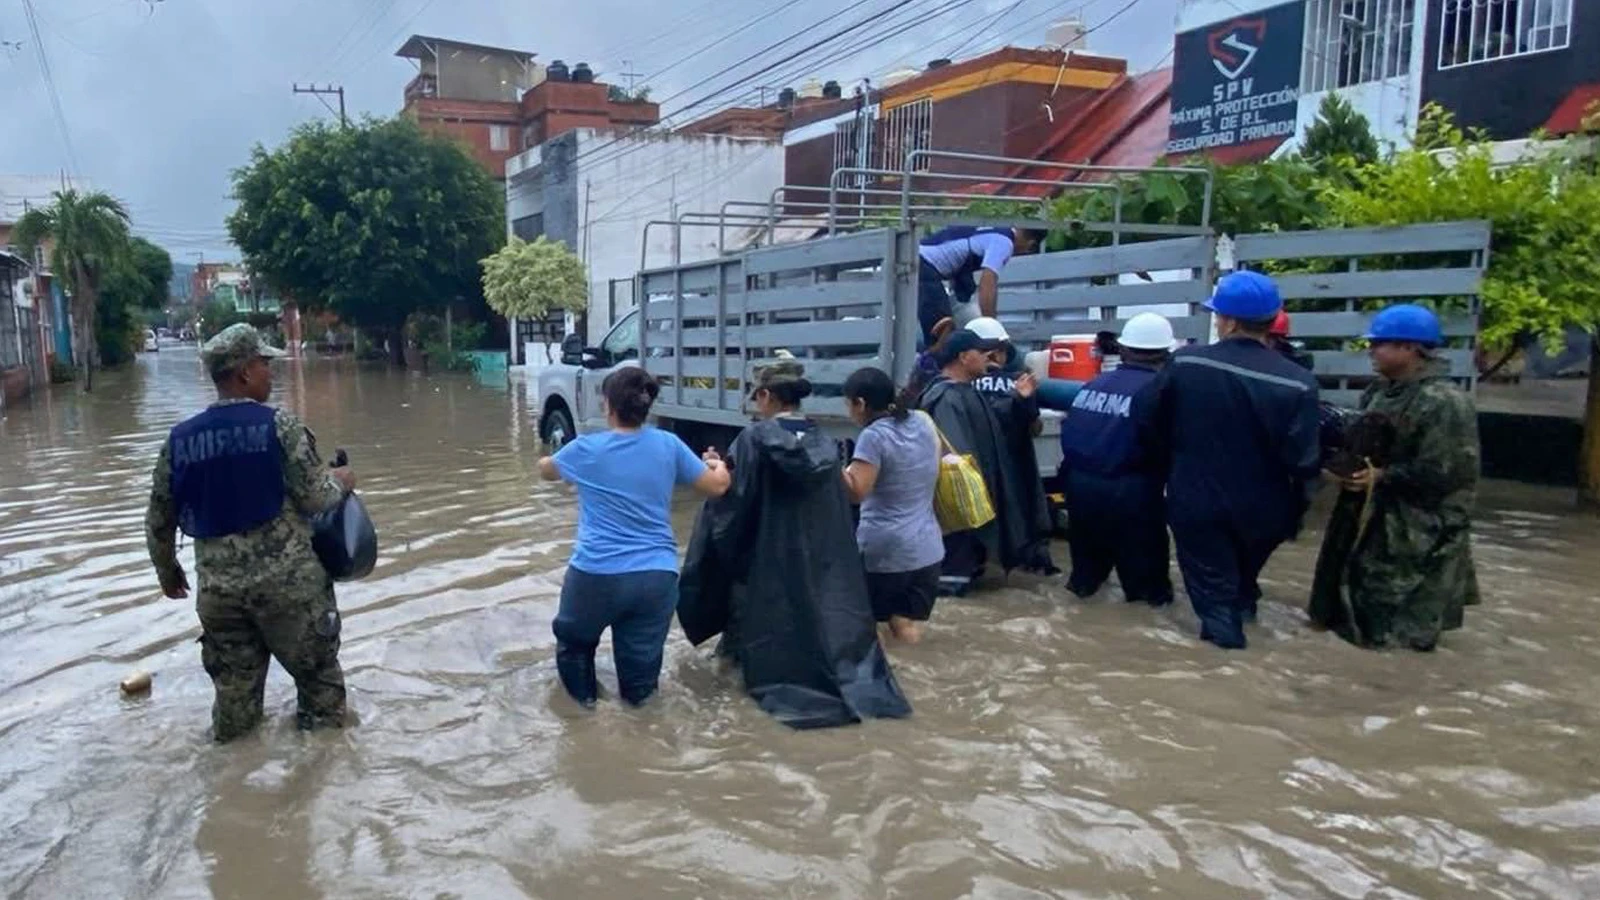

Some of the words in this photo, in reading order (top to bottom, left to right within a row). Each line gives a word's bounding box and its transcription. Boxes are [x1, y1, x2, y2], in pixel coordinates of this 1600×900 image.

[1215, 86, 1299, 116] PROTECCIÓN
[1167, 131, 1234, 153] SEGURIDAD
[1240, 119, 1296, 142] PRIVADA
[1201, 120, 1214, 134] S.
[1220, 115, 1239, 130] DE
[1072, 389, 1132, 418] MARINA
